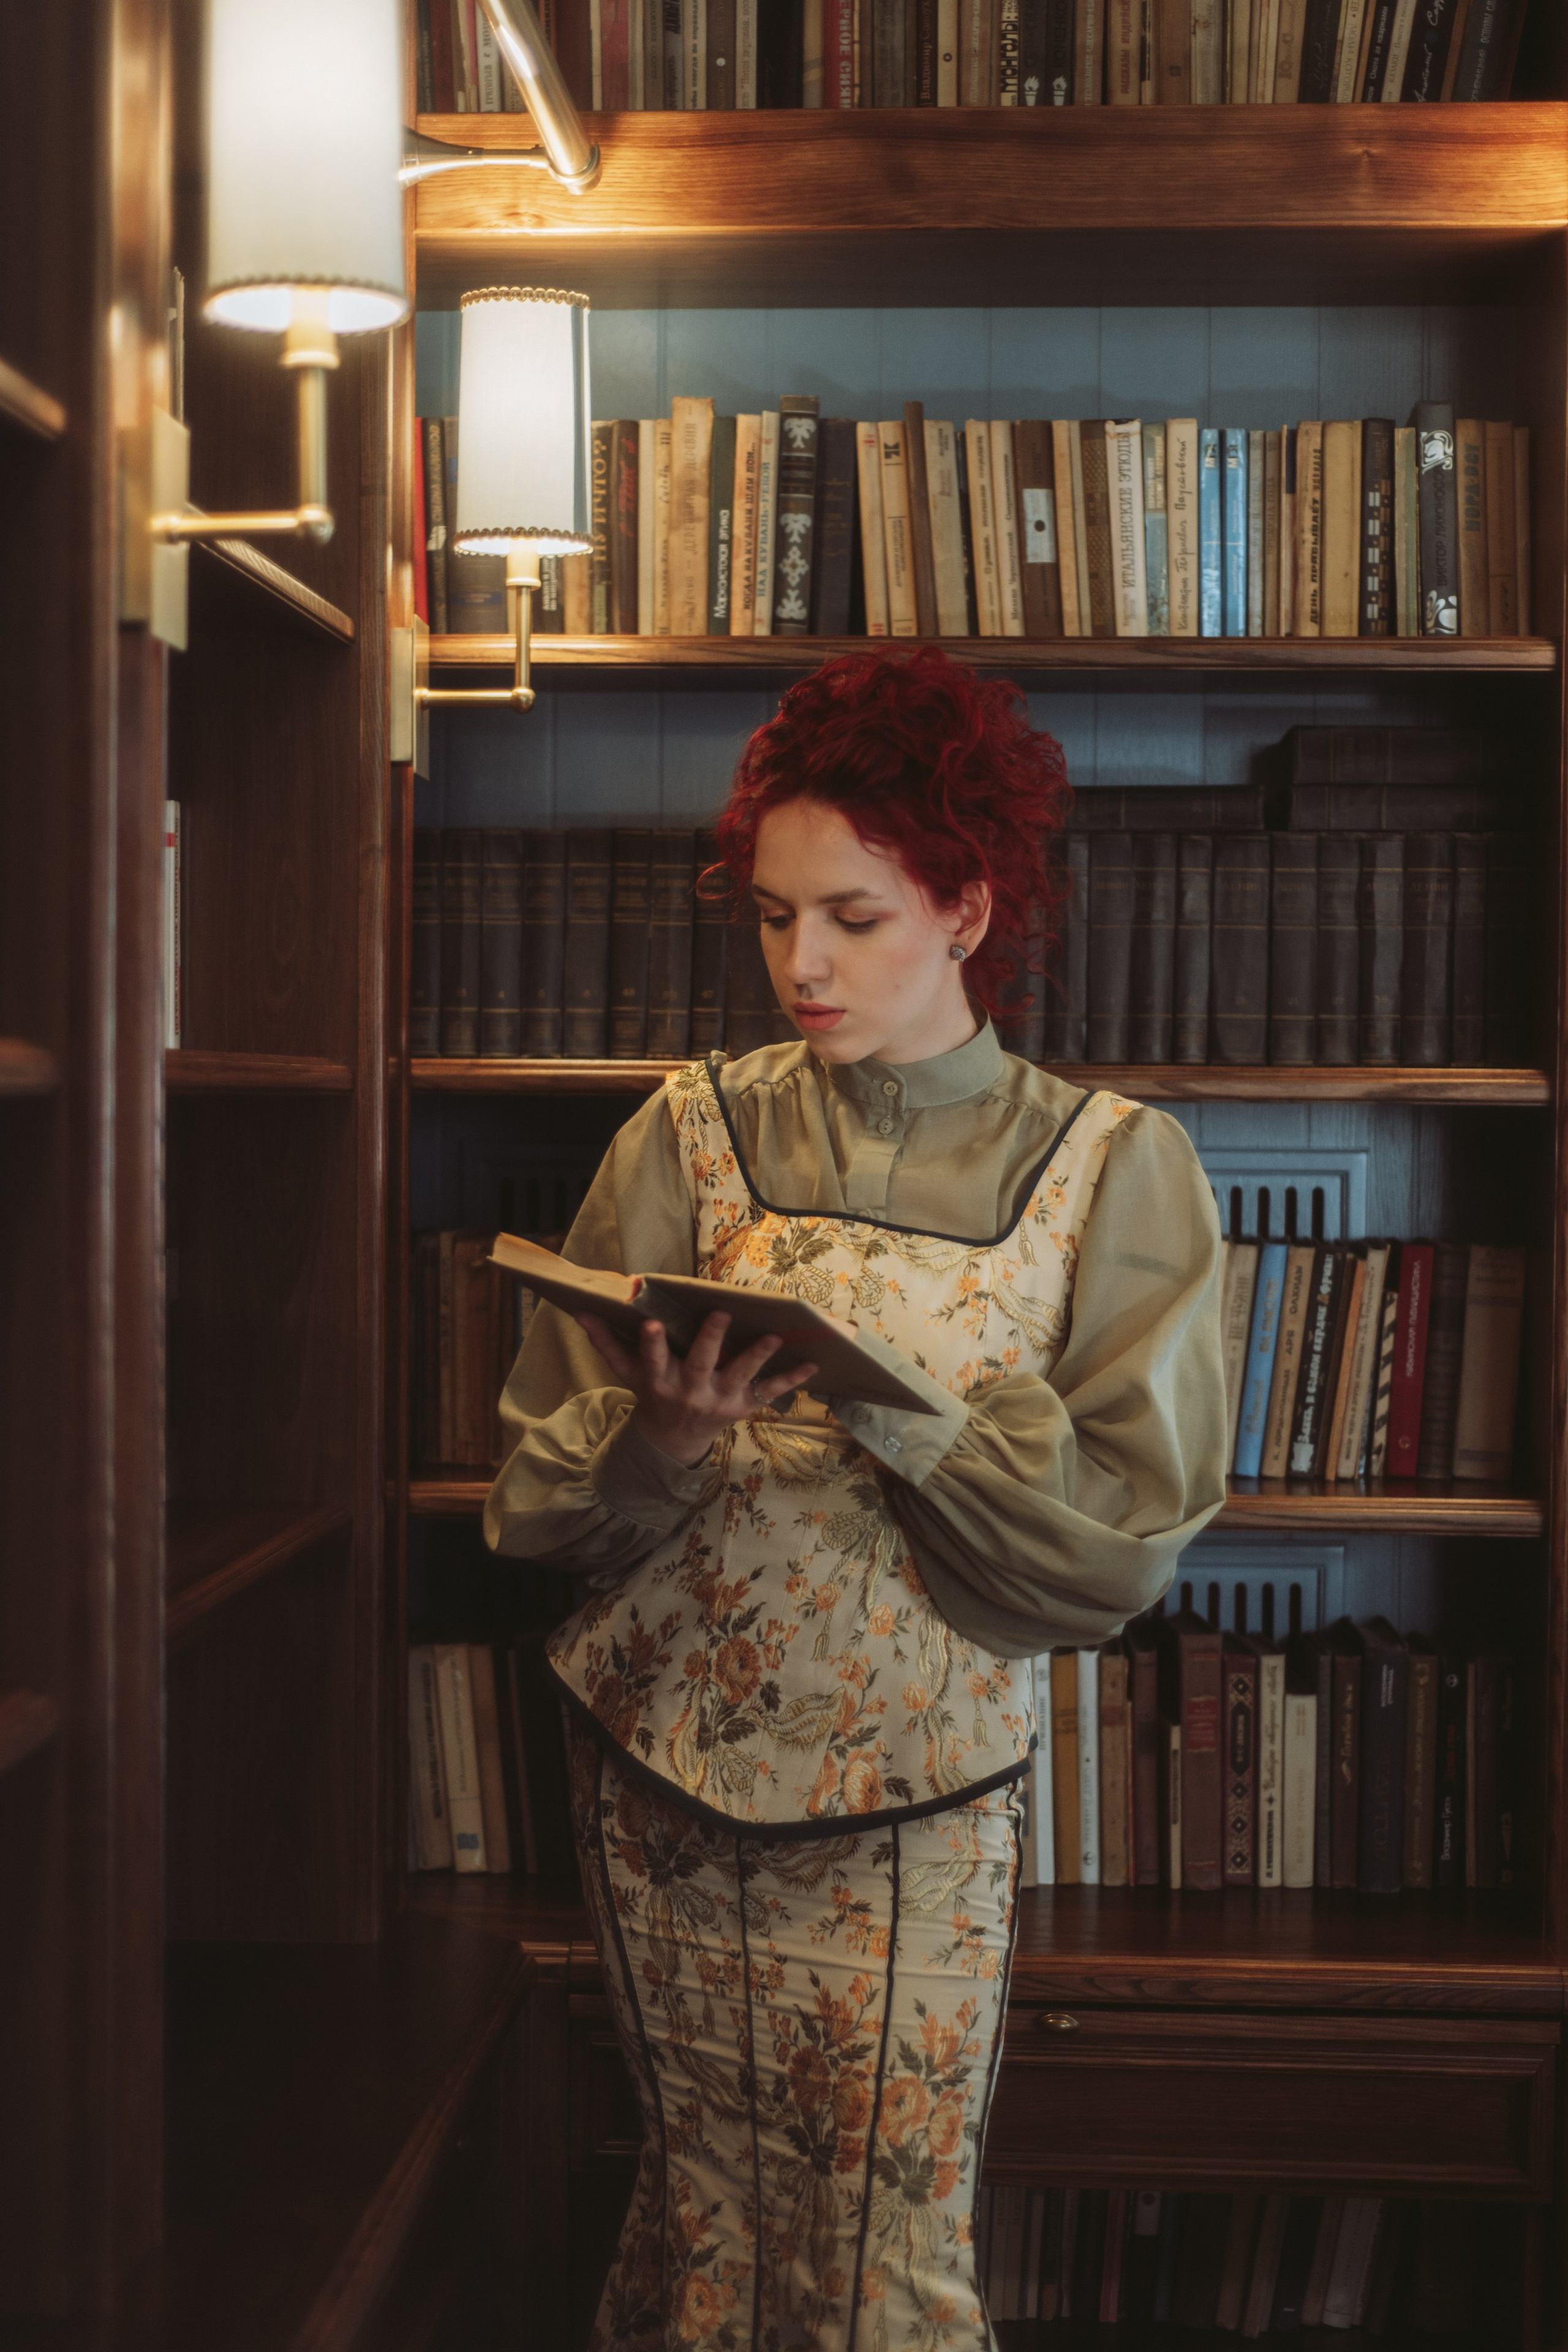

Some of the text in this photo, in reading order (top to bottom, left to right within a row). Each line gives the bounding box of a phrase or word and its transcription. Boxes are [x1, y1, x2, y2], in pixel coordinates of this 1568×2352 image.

[839, 0, 852, 56] ЕРНОЕ
[1053, 0, 1068, 69] КОНЕНКО
[1120, 0, 1133, 43] ИНДИЙСК
[1369, 56, 1379, 80] Охота
[1376, 6, 1389, 43] кварками
[919, 0, 933, 99] Владимир Солоух
[745, 477, 755, 504] ШЛИ
[1174, 437, 1193, 511] Паустовский
[592, 439, 607, 562] НУ И ЧТО?
[1117, 431, 1136, 589] ИТАЛЬЯНСКИЕ ЭТЮДЫ
[745, 508, 755, 555] КУБАНИ
[756, 461, 771, 597] НАД КУБАНЬ-РЕКОЙ
[713, 509, 730, 619] Марксистская этика
[744, 557, 753, 571] НА
[1436, 540, 1448, 587] ВИКТОР
[742, 576, 753, 610] КОГДА
[1310, 589, 1319, 624] ДЕНЬ
[1288, 1265, 1303, 1315] ОЛХИДЫ
[1284, 1330, 1295, 1355] АРЯ
[1306, 1354, 1322, 1394] самом
[1440, 1820, 1452, 1861] Владимир
